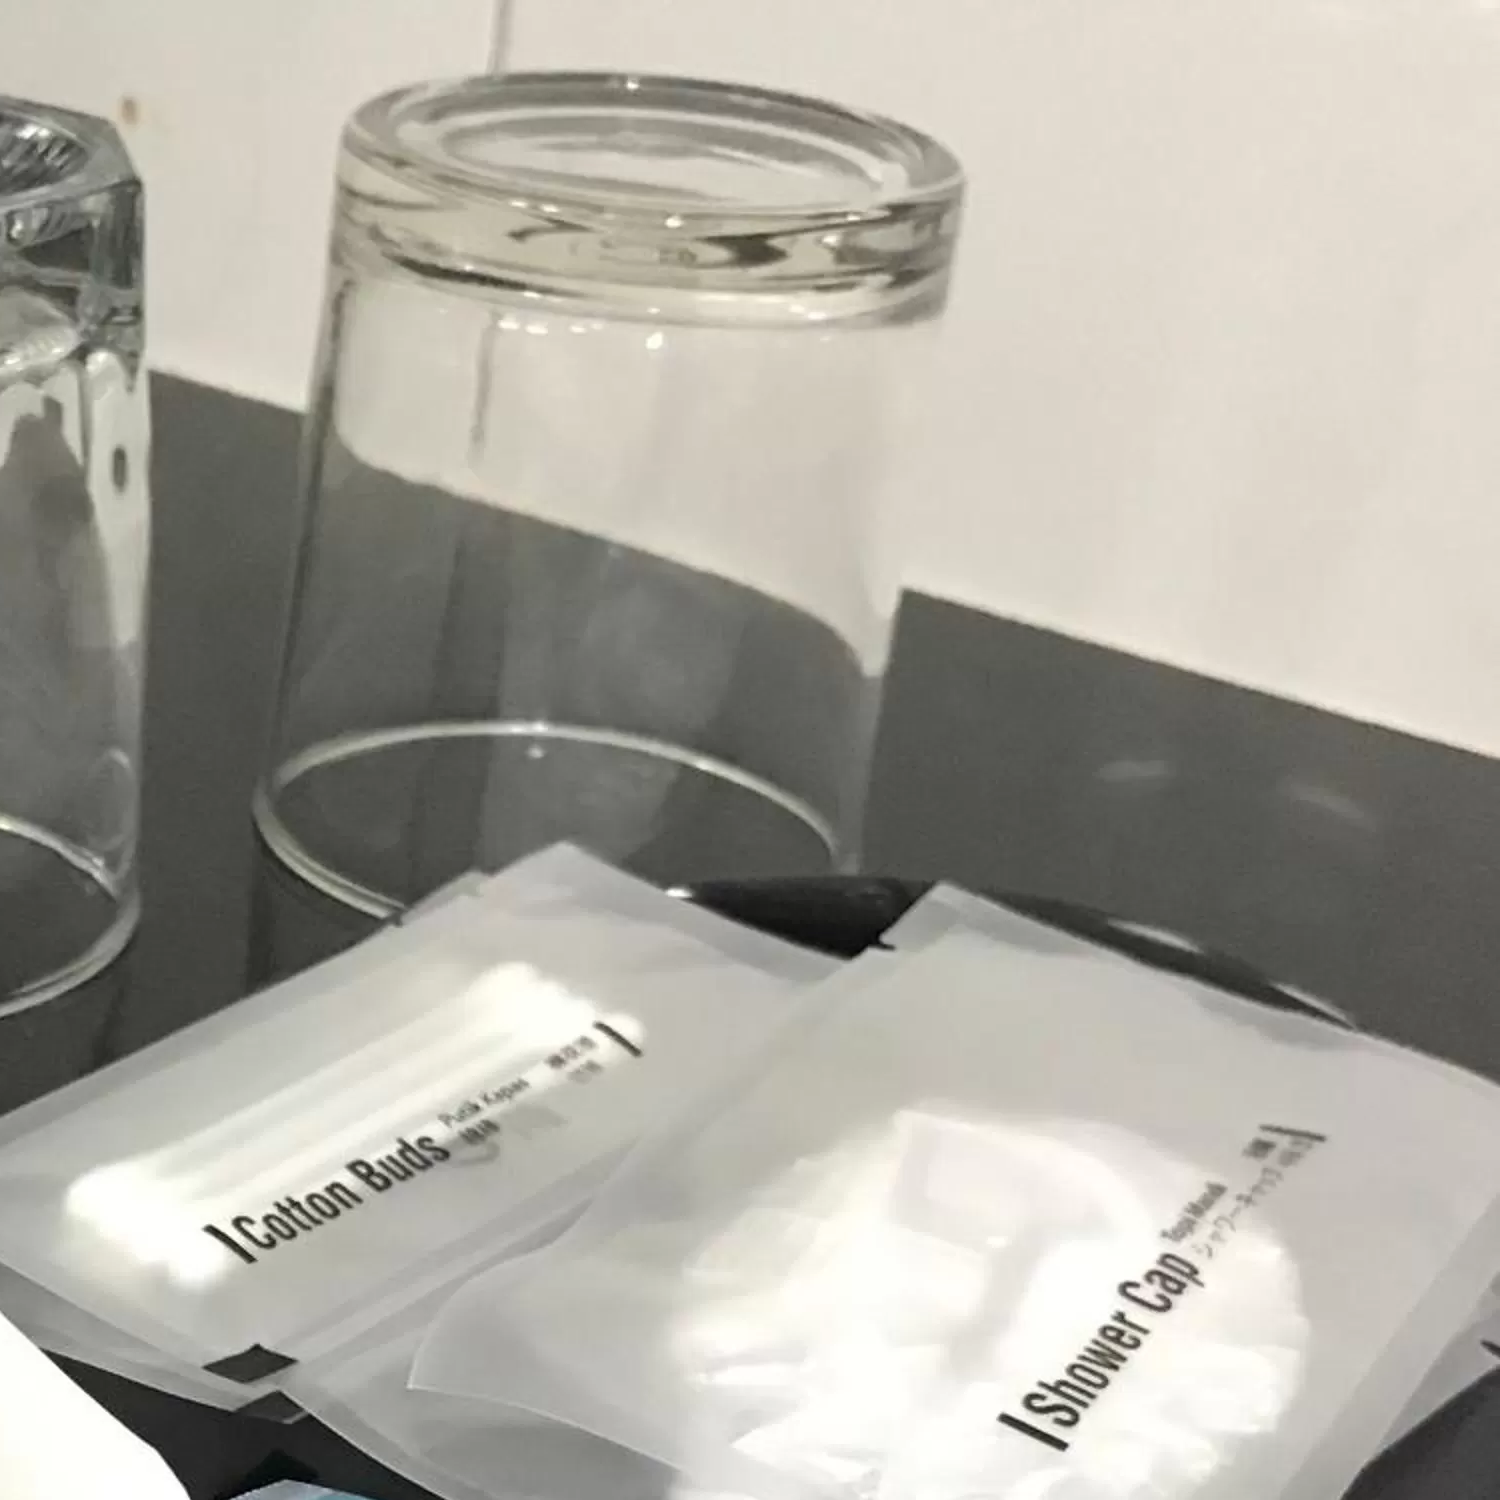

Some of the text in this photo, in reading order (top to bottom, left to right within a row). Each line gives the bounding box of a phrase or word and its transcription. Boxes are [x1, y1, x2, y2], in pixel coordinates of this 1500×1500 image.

[231, 1133, 451, 1252] Cotton Buds
[1020, 1251, 1206, 1429] Shower Cap
